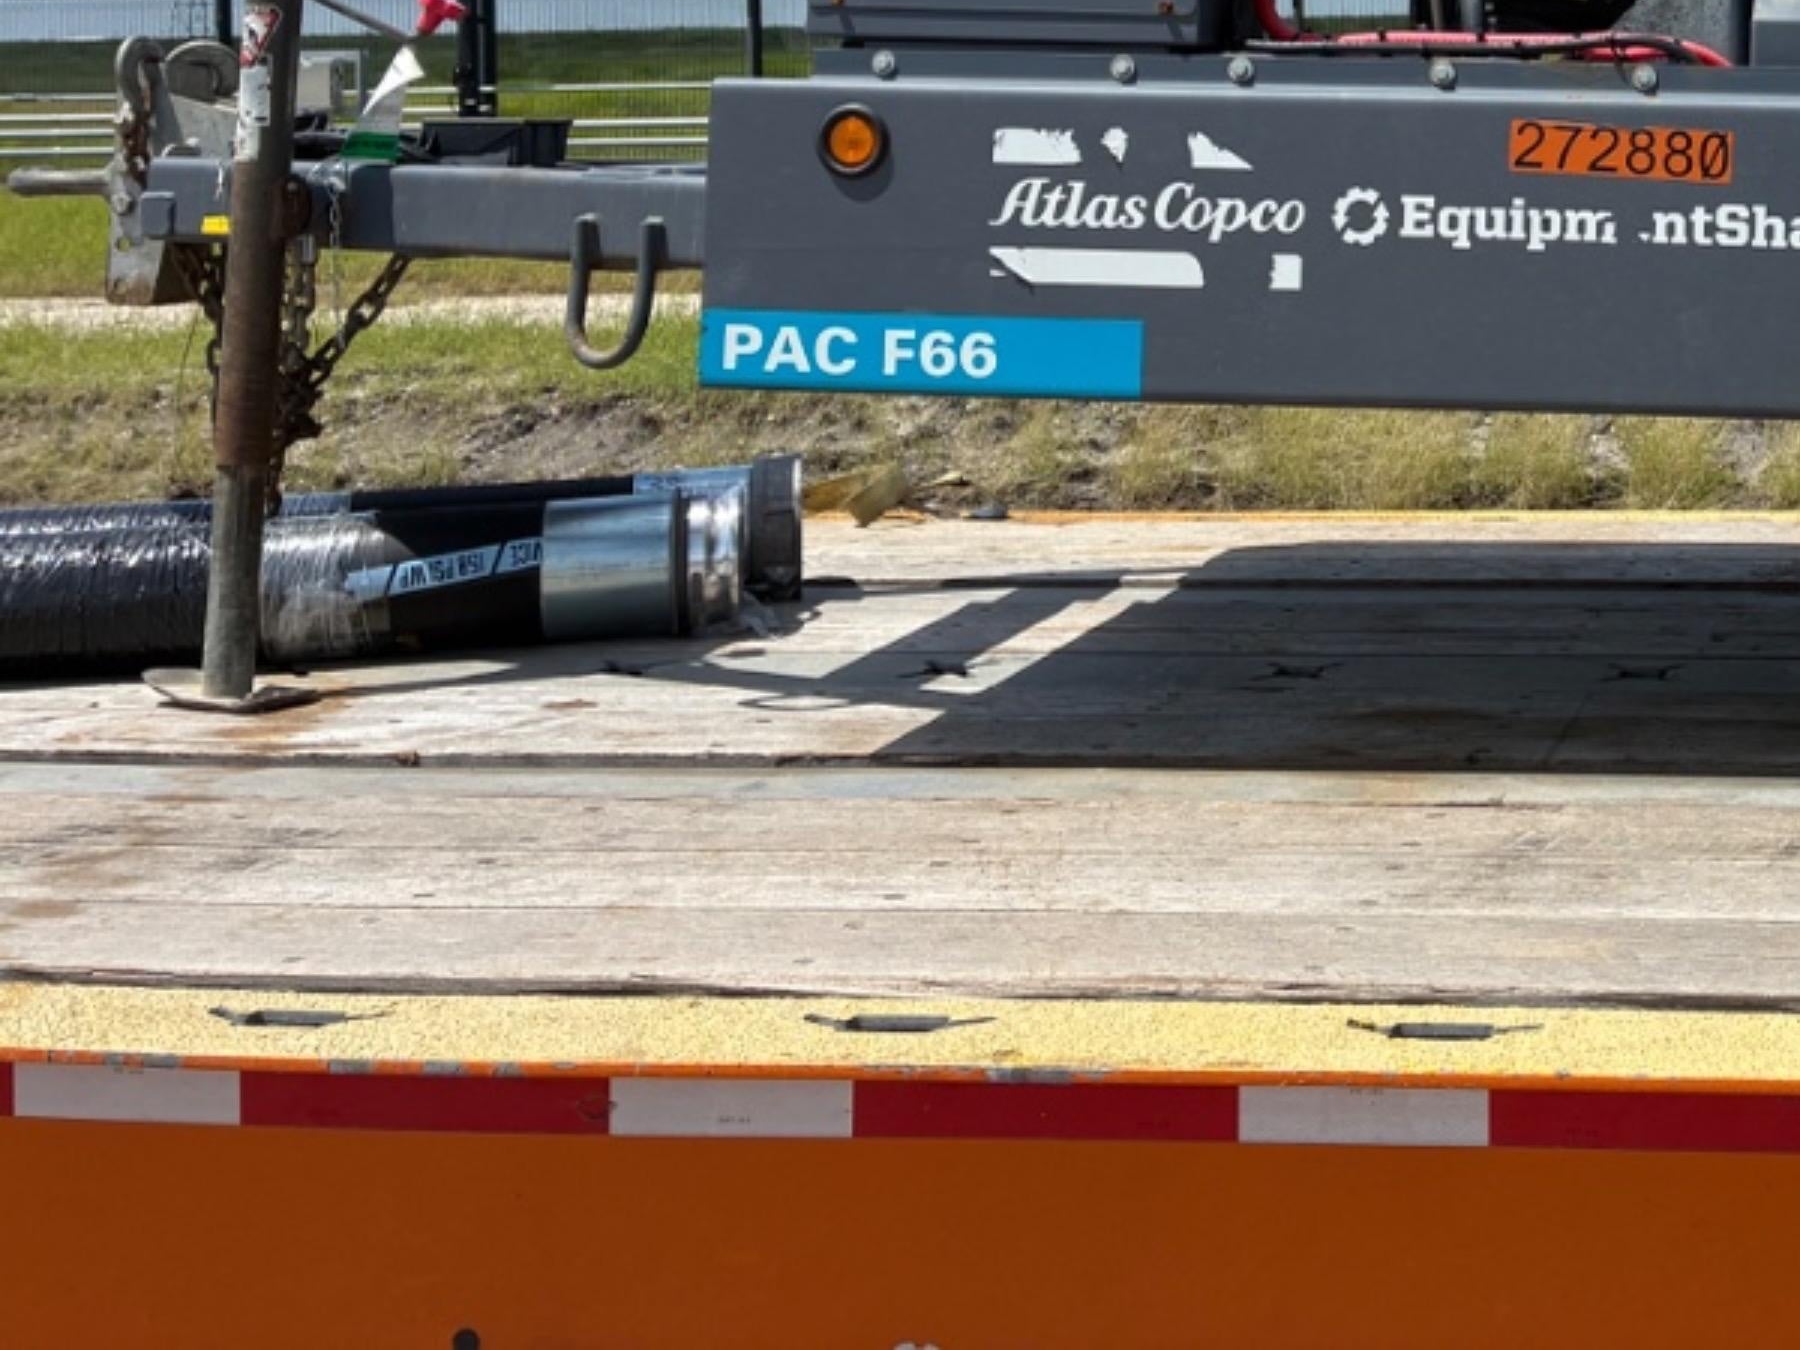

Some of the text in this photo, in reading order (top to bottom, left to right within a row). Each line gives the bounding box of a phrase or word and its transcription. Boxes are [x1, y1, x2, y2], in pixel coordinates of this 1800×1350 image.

[1514, 122, 1729, 179] 272880
[989, 177, 1306, 243] Atlas Copco
[722, 324, 998, 378] PAC F66
